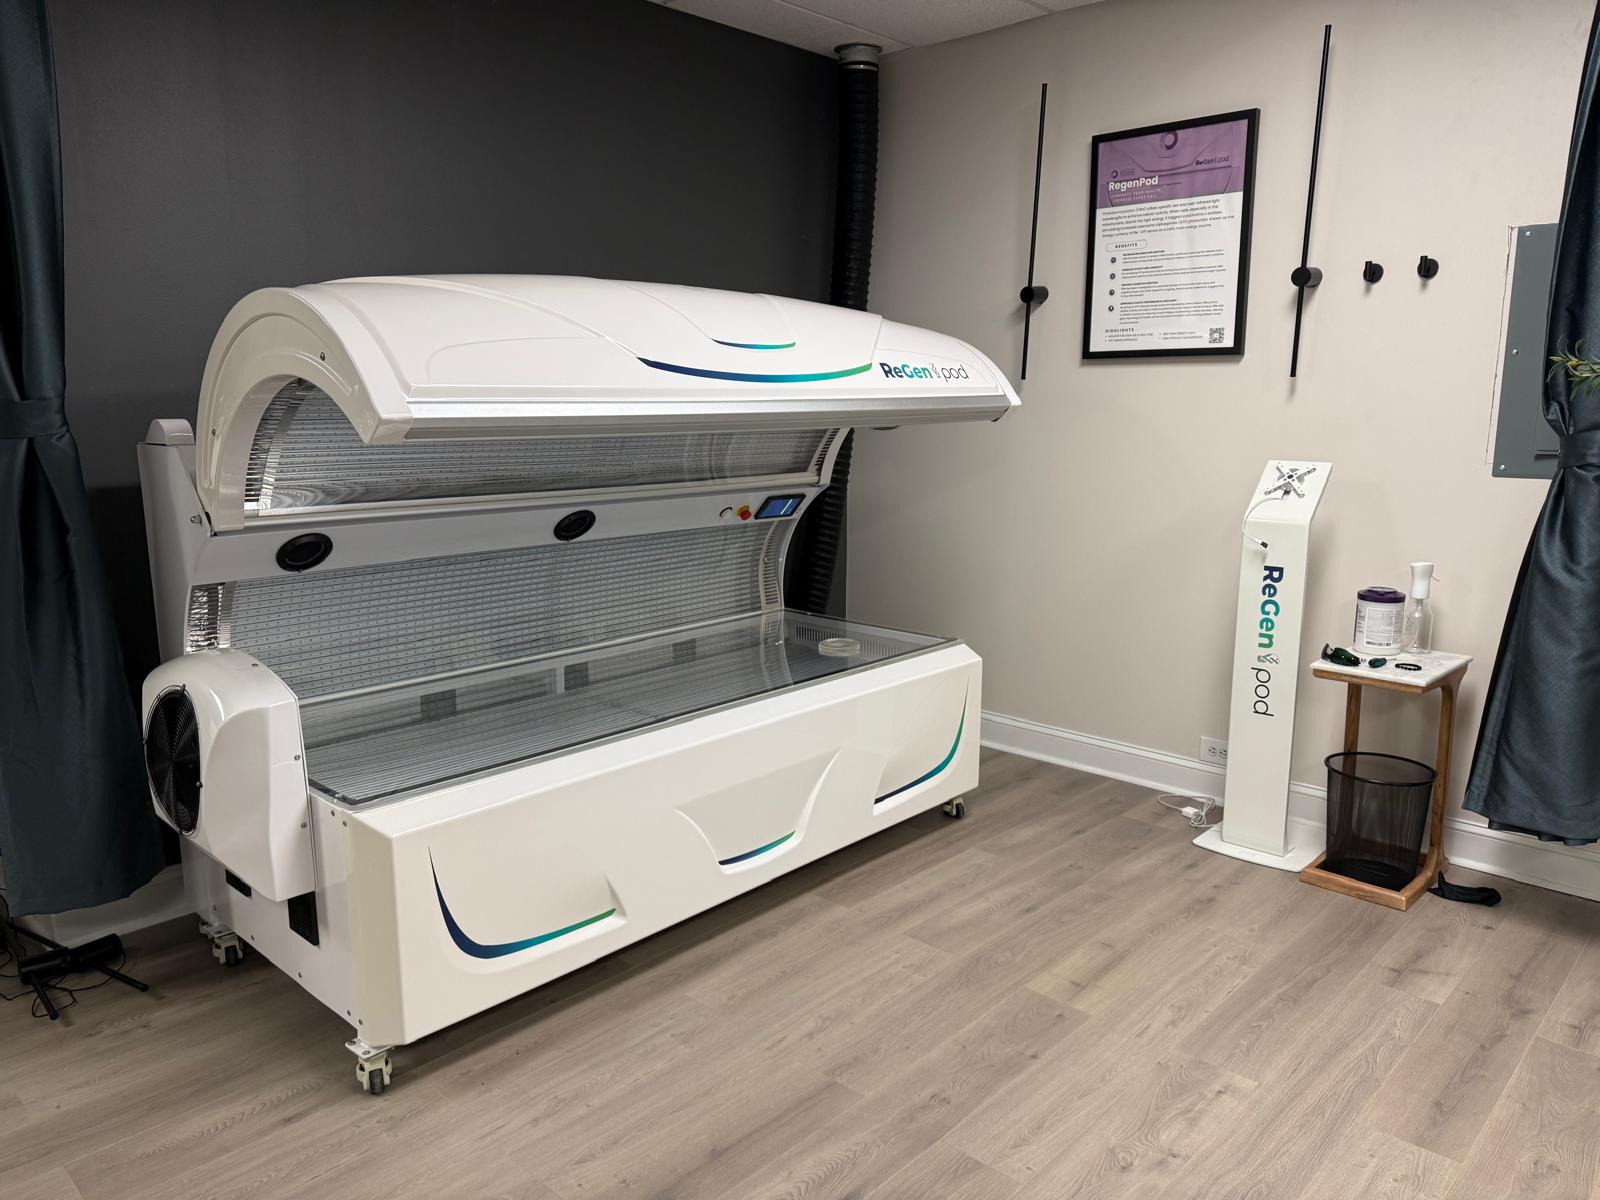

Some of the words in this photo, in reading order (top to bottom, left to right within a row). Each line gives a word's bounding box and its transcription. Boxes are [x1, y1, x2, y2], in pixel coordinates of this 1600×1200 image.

[1108, 175, 1159, 192] RegenPod
[879, 362, 933, 379] ReGen
[941, 364, 970, 382] pod
[1257, 565, 1285, 649] ReGen
[1251, 666, 1274, 717] pod
